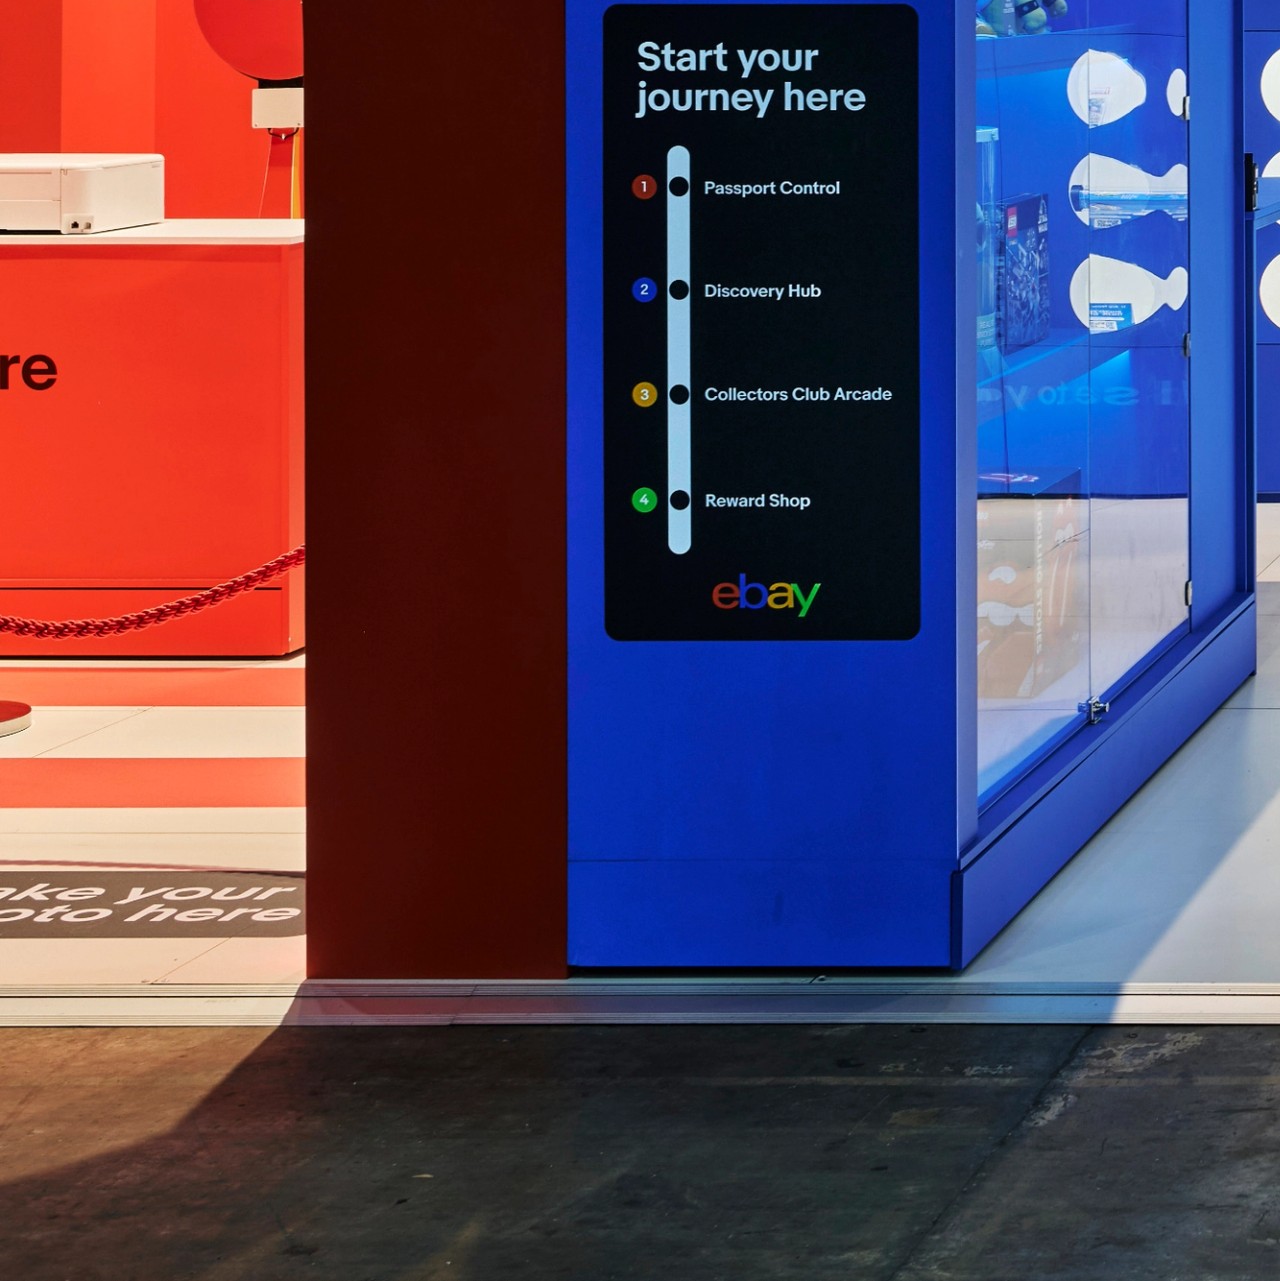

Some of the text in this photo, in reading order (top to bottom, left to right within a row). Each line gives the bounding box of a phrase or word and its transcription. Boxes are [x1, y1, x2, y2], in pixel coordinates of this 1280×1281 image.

[637, 41, 819, 78] Start your
[634, 80, 866, 118] journey here
[641, 181, 648, 192] 1
[704, 181, 840, 197] Passport Control
[640, 284, 649, 296] 2
[704, 284, 822, 300] Discovery Hub
[640, 389, 649, 400] 3
[704, 387, 893, 401] Collectors Club Arcade
[639, 494, 649, 505] 4
[705, 494, 811, 510] Reward Shop
[712, 573, 821, 617] ebay
[114, 885, 298, 905] your
[124, 904, 302, 923] here
